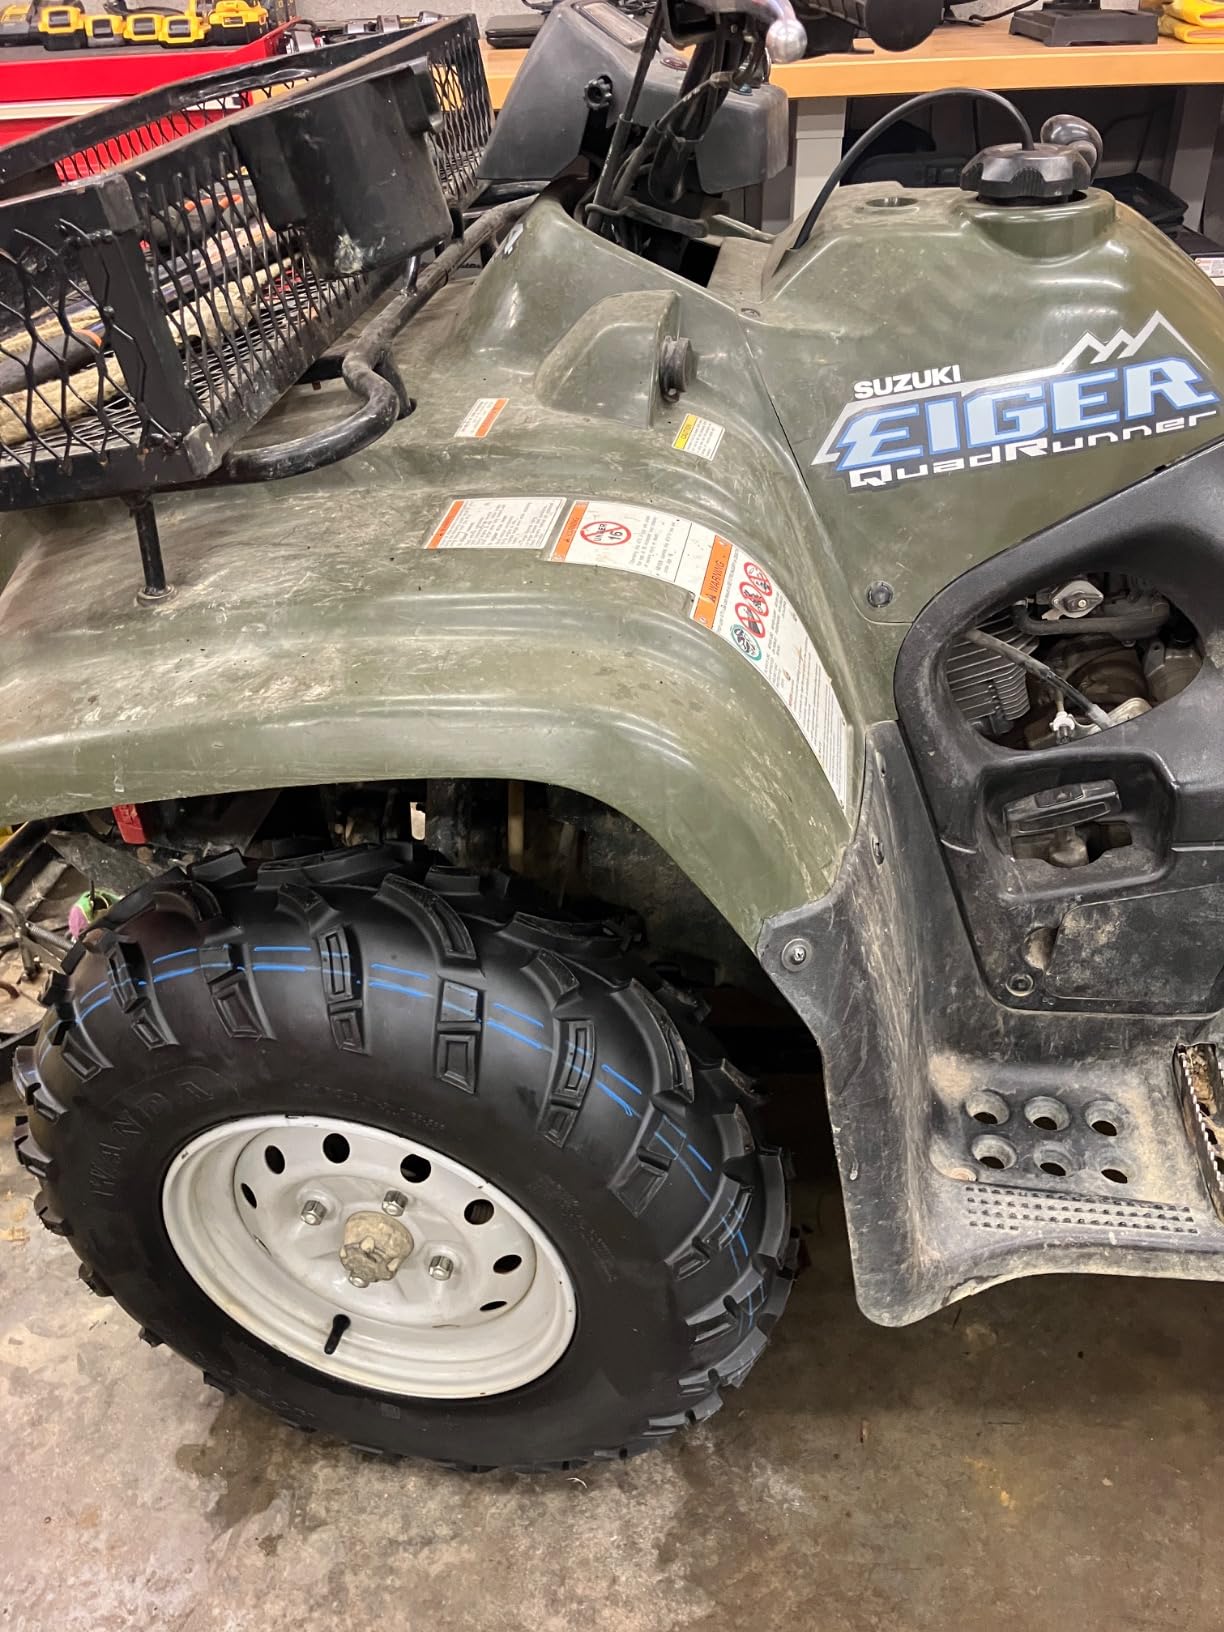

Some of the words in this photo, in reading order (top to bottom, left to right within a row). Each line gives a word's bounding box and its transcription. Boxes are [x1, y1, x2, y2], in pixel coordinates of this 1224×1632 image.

[853, 364, 962, 400] SUZUKI
[835, 357, 1220, 471] EIGER
[848, 410, 1217, 489] QuadRunner
[608, 530, 623, 540] 16
[709, 560, 725, 593] WARNING
